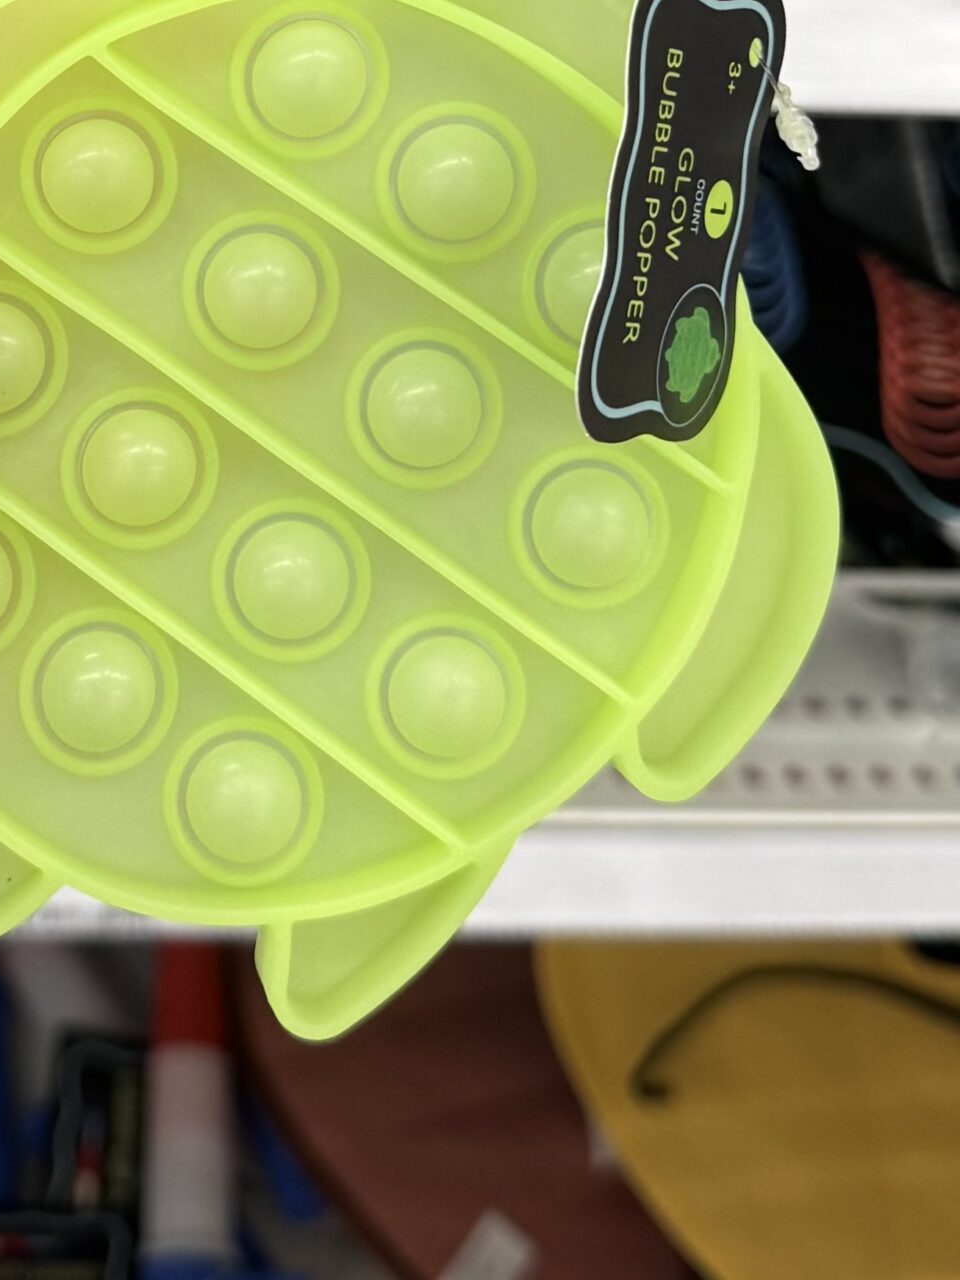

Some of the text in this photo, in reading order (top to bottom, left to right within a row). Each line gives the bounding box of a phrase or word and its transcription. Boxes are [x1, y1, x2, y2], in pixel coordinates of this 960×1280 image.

[727, 61, 742, 95] 3+
[622, 47, 684, 344] BUBBLE POPPER
[664, 147, 695, 262] GLOW
[690, 178, 706, 235] COUNT
[709, 202, 728, 217] 1
